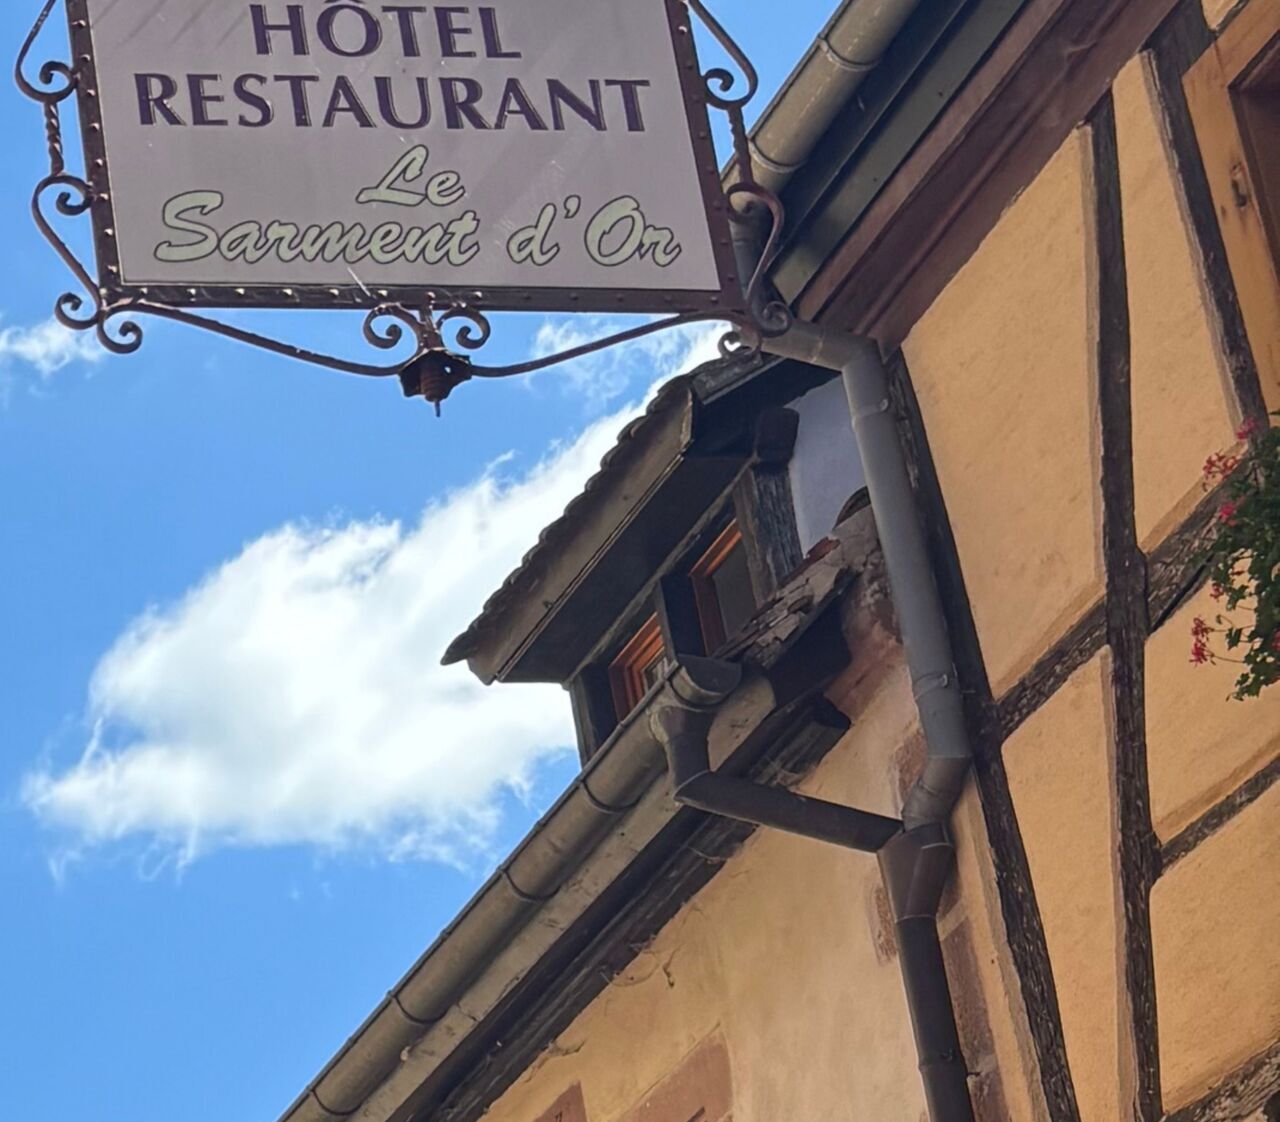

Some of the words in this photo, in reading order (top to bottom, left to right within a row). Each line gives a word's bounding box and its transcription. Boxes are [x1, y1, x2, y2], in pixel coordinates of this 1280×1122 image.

[249, 0, 523, 59] HÔTEL
[134, 72, 651, 132] RESTAURANT
[355, 144, 466, 207] Le
[153, 190, 481, 267] Sarment
[506, 195, 682, 267] d'Or
